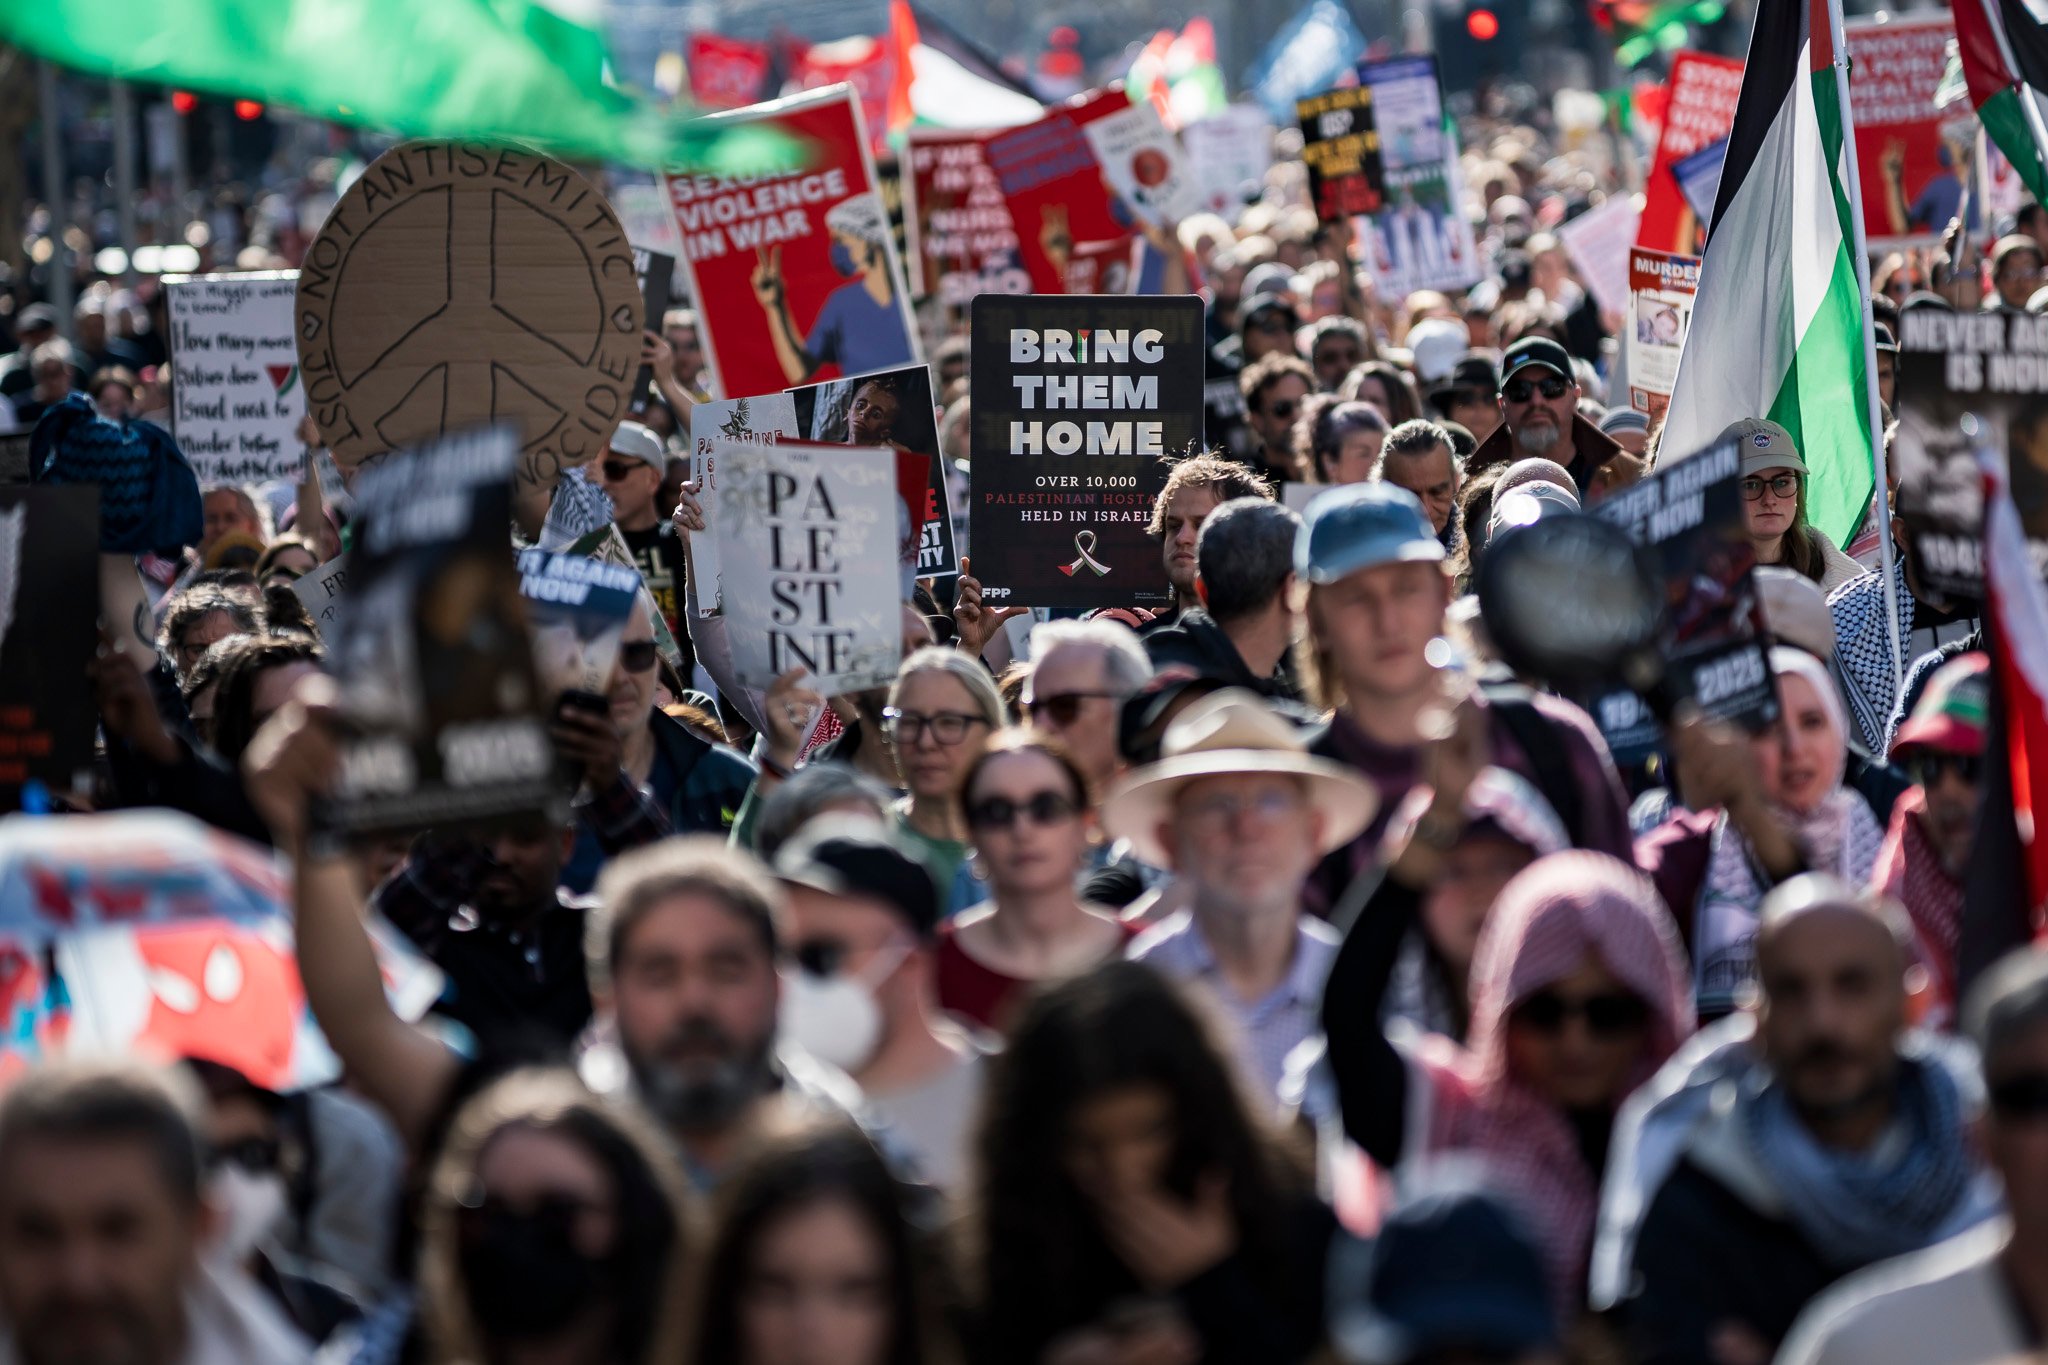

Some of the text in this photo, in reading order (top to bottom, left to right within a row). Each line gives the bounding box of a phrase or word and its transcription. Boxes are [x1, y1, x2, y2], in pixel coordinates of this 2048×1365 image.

[675, 167, 848, 231] VIOLENCE
[301, 142, 635, 299] NOT ANTISEMITIC
[685, 208, 813, 261] IN WAR
[1010, 328, 1164, 364] BRING
[1902, 309, 2006, 354] NEVER
[1013, 375, 1158, 410] THEM
[1945, 353, 1985, 394] IS
[302, 349, 363, 448] JUST
[514, 350, 629, 494] NOCIDE
[1010, 420, 1164, 456] HOME
[698, 430, 784, 456] PAESTINE
[1035, 476, 1137, 489] OVER 10,000
[1667, 442, 1740, 504] AGAIN
[767, 470, 836, 522] PA
[985, 493, 1157, 505] PALESTINIAN HOSTA
[1021, 510, 1155, 523] HELD IN ISRAEL
[1650, 490, 1706, 546] NOW
[768, 524, 842, 573] LE
[320, 571, 347, 599] FR
[518, 574, 592, 606] NOW
[543, 553, 641, 594] AGAIN
[981, 587, 1011, 598] FPP
[770, 577, 843, 626] ST
